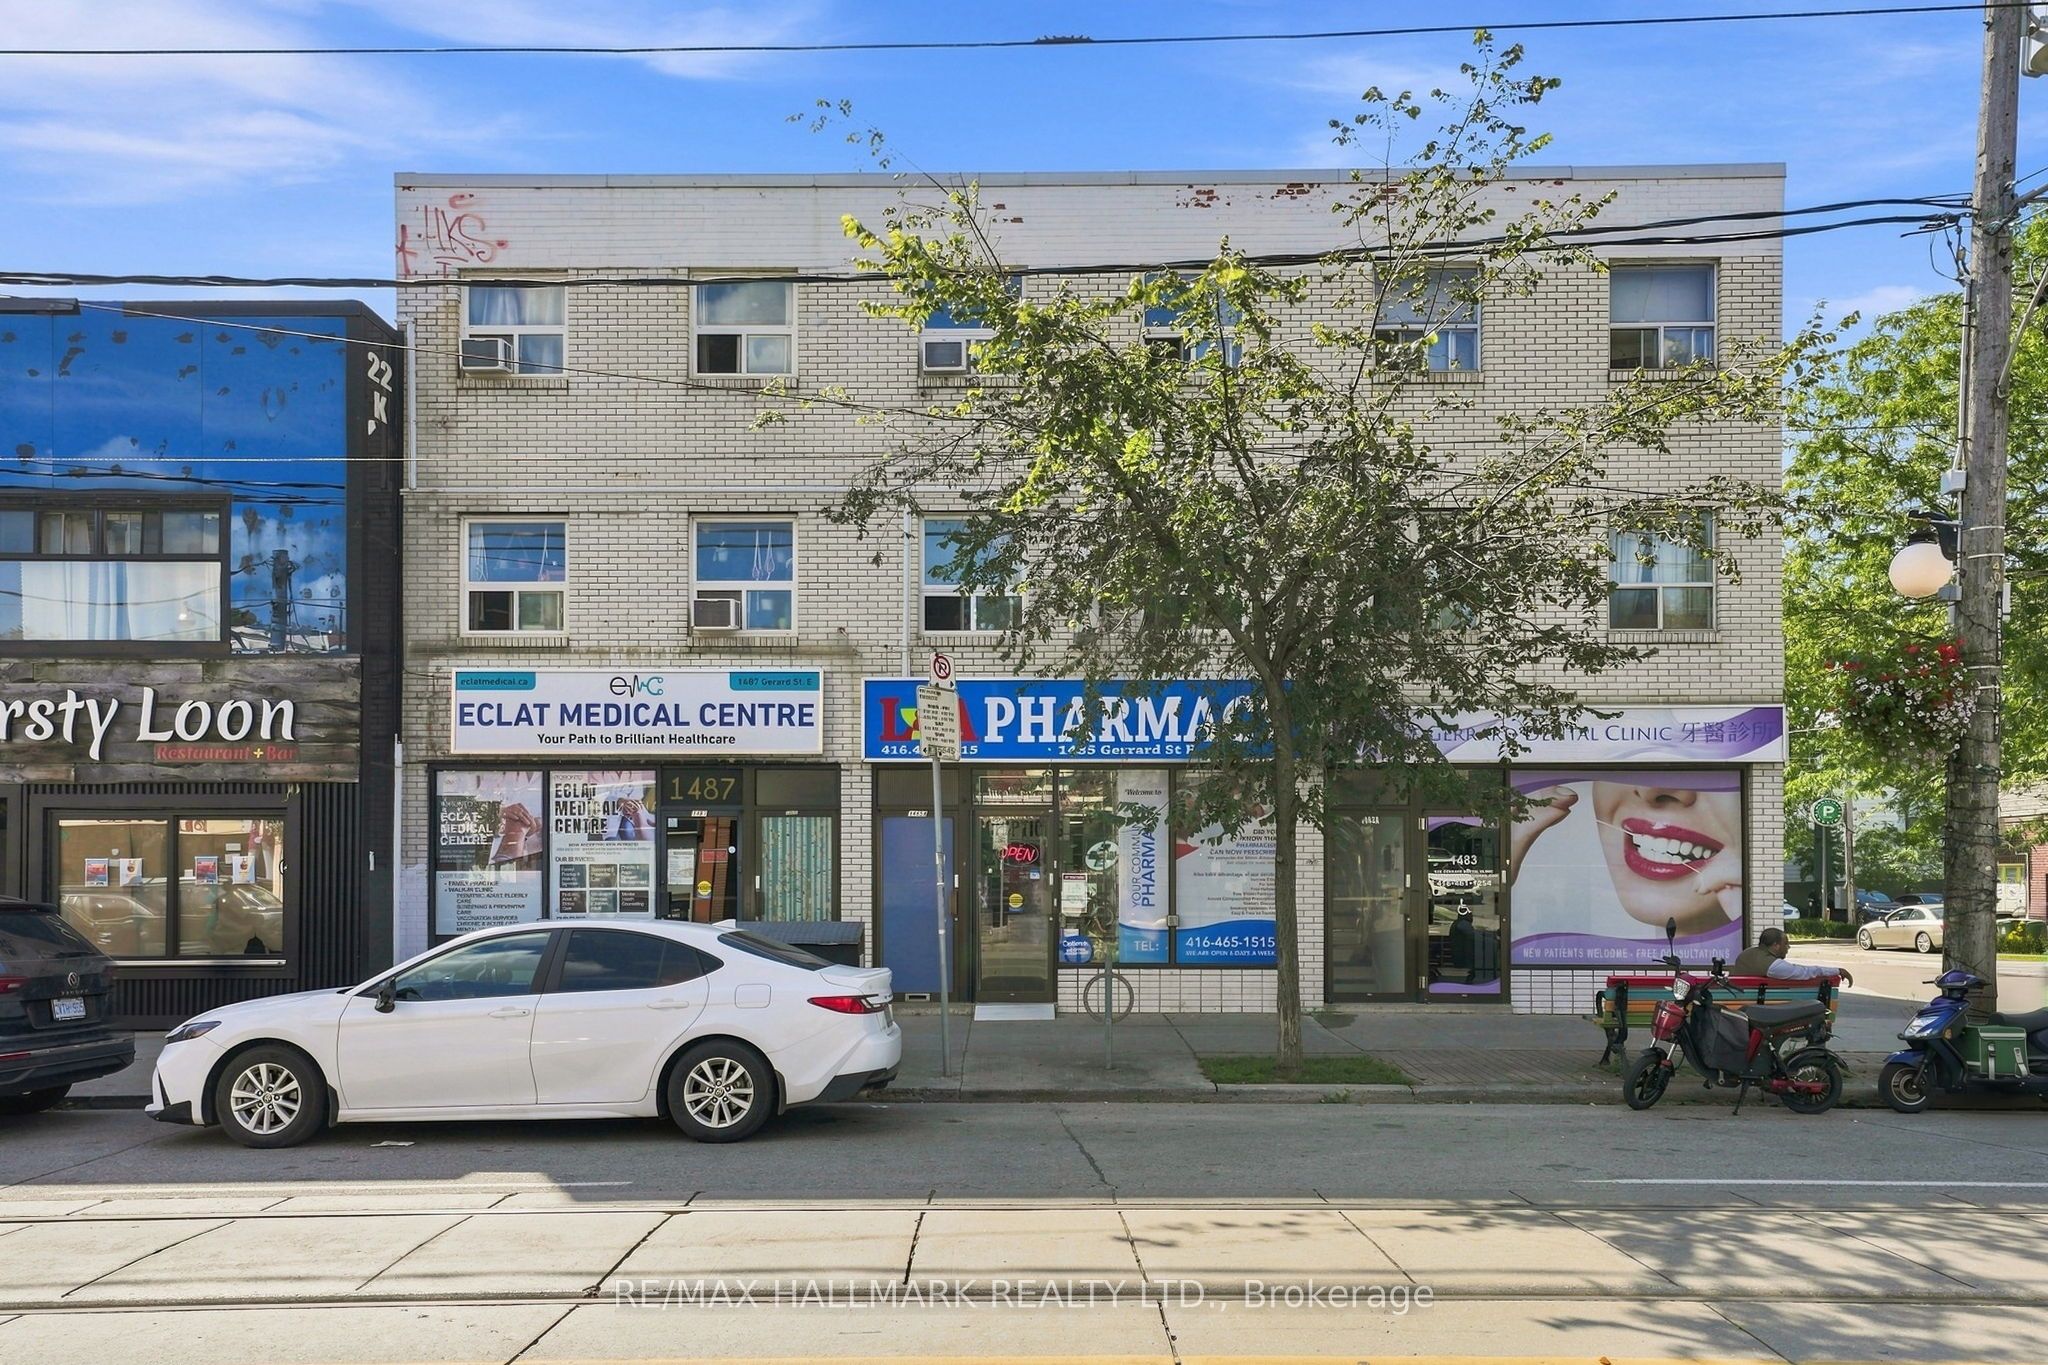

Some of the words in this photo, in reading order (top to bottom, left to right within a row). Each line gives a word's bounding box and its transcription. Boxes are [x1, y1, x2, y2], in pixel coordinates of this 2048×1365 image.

[460, 677, 528, 686] eclatmedical.ca
[807, 678, 813, 686] E
[136, 686, 296, 742] Loon
[459, 702, 550, 727] ECLAT
[560, 702, 690, 727] MEDICAL
[699, 703, 815, 727] CENTRE
[537, 733, 565, 744] Your
[569, 733, 596, 744] Path
[600, 733, 612, 744] to
[616, 733, 665, 744] Brilliant
[669, 733, 736, 744] Healthcare
[1605, 725, 1673, 742] CLINIC
[156, 745, 250, 761] Restaurant
[266, 745, 296, 761] Bar
[1100, 744, 1159, 756] Gerrard
[1167, 745, 1183, 755] St
[554, 783, 597, 799] ECLAT
[670, 776, 736, 800] 1487
[1125, 788, 1153, 796] Welcome
[1154, 788, 1162, 796] to
[440, 811, 479, 822] ECLAT
[440, 823, 493, 834] MEDICAL
[554, 818, 608, 834] CENTRE
[440, 835, 487, 846] CENTRE
[1000, 846, 1036, 861] OPEN
[1451, 854, 1478, 866] 1483
[1141, 830, 1156, 907] PHARMA
[1132, 877, 1142, 908] YOUR
[1134, 941, 1159, 951] TEL:
[1185, 936, 1276, 948] 416-465-1515
[1523, 948, 1542, 959] NEW
[1544, 948, 1584, 959] PATIENTS
[1587, 948, 1628, 959] WELCOME
